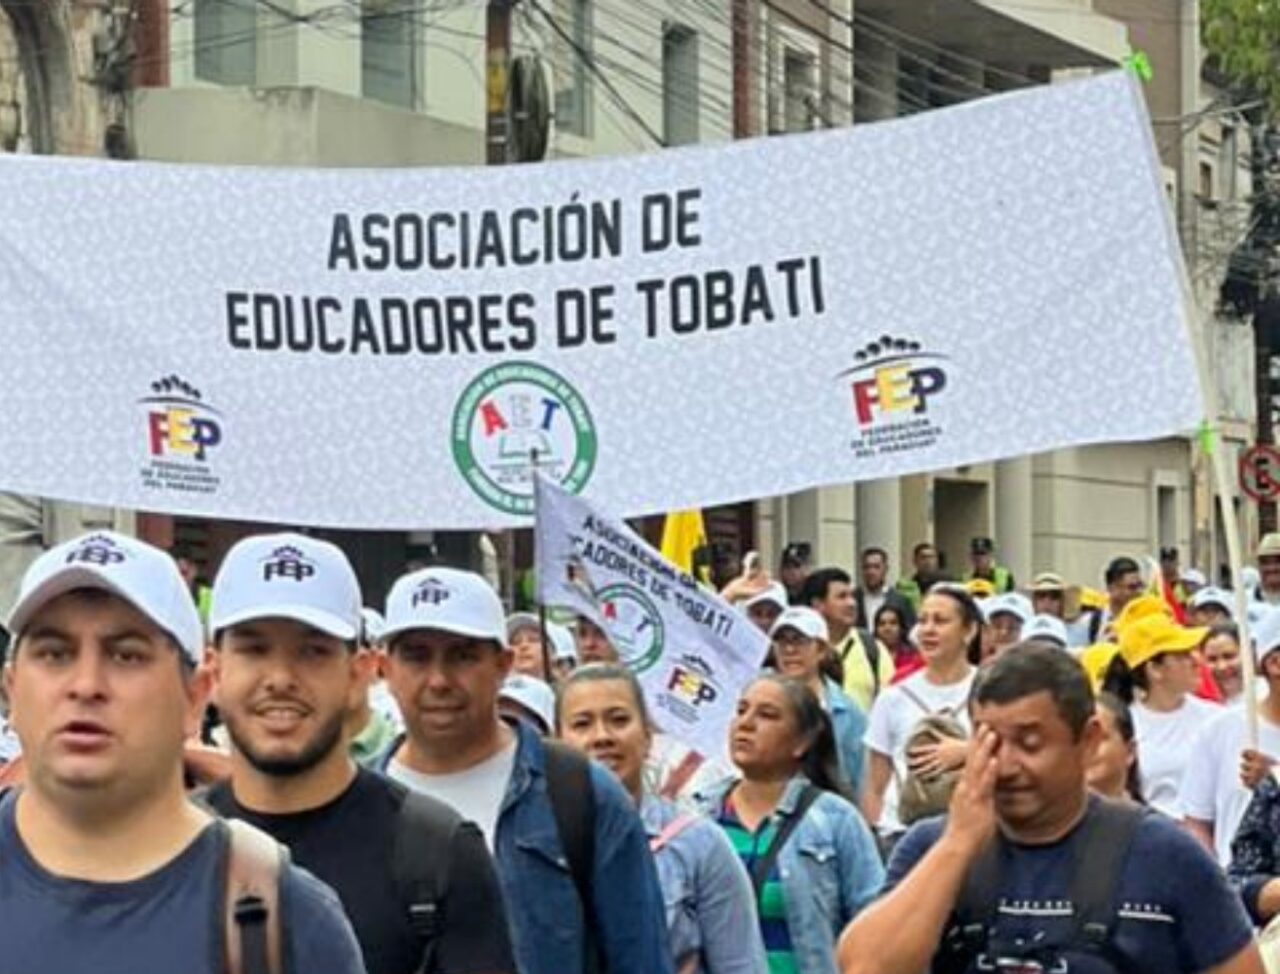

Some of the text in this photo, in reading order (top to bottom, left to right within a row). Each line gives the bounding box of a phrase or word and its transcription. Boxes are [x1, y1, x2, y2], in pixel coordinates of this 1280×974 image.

[327, 188, 701, 270] ASOCIACIÓN DE
[225, 255, 825, 355] EDUCADORES DE TOBATI
[852, 362, 947, 424] FEP
[148, 405, 222, 461] FEP
[673, 590, 734, 638] TOBATI
